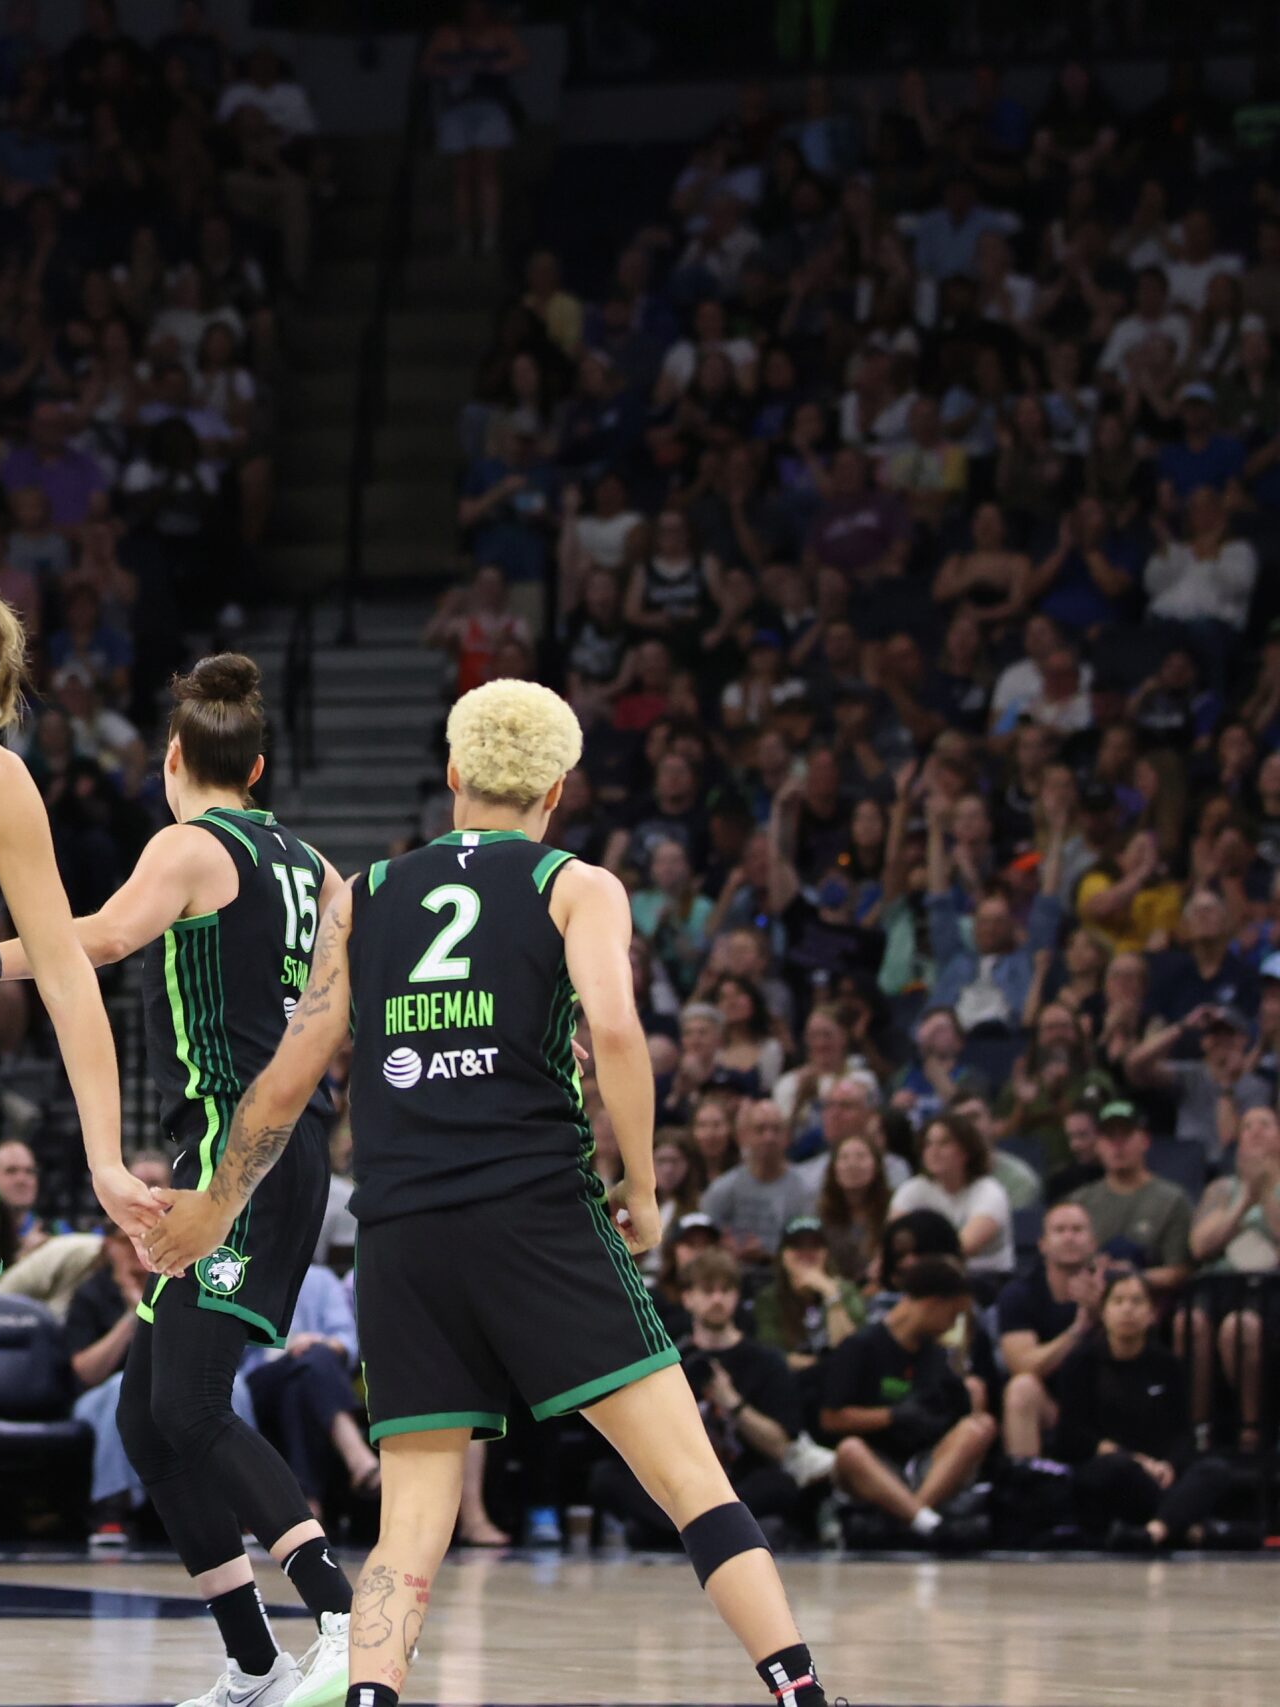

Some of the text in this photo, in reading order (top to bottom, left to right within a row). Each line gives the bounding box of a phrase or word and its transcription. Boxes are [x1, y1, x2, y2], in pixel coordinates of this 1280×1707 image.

[272, 863, 317, 954] 15
[408, 883, 481, 983] 2
[385, 990, 494, 1036] HIEDEMAN
[426, 1047, 499, 1080] AT&T
